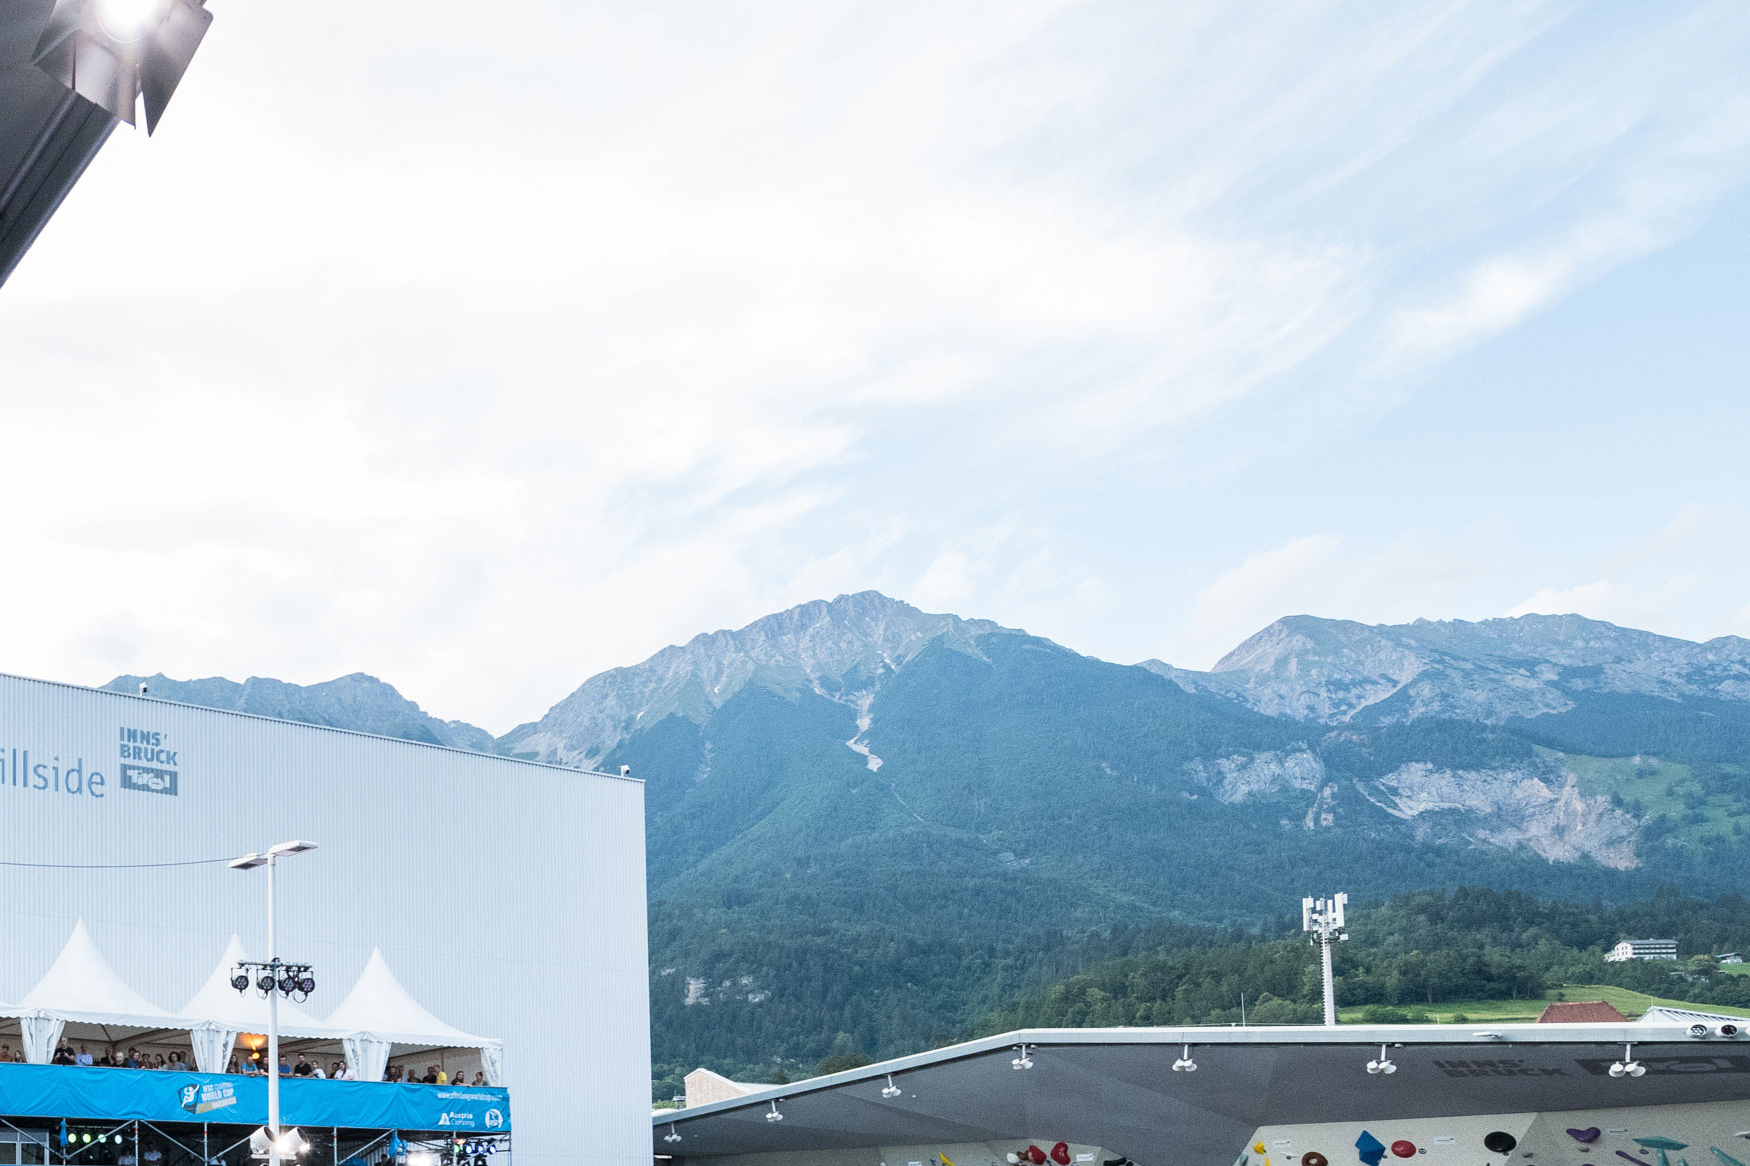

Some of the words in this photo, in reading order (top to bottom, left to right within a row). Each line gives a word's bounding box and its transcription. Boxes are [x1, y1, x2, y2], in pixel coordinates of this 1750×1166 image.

[119, 726, 167, 747] INNS'
[119, 743, 178, 767] BRUCK
[126, 768, 170, 790] Tirol
